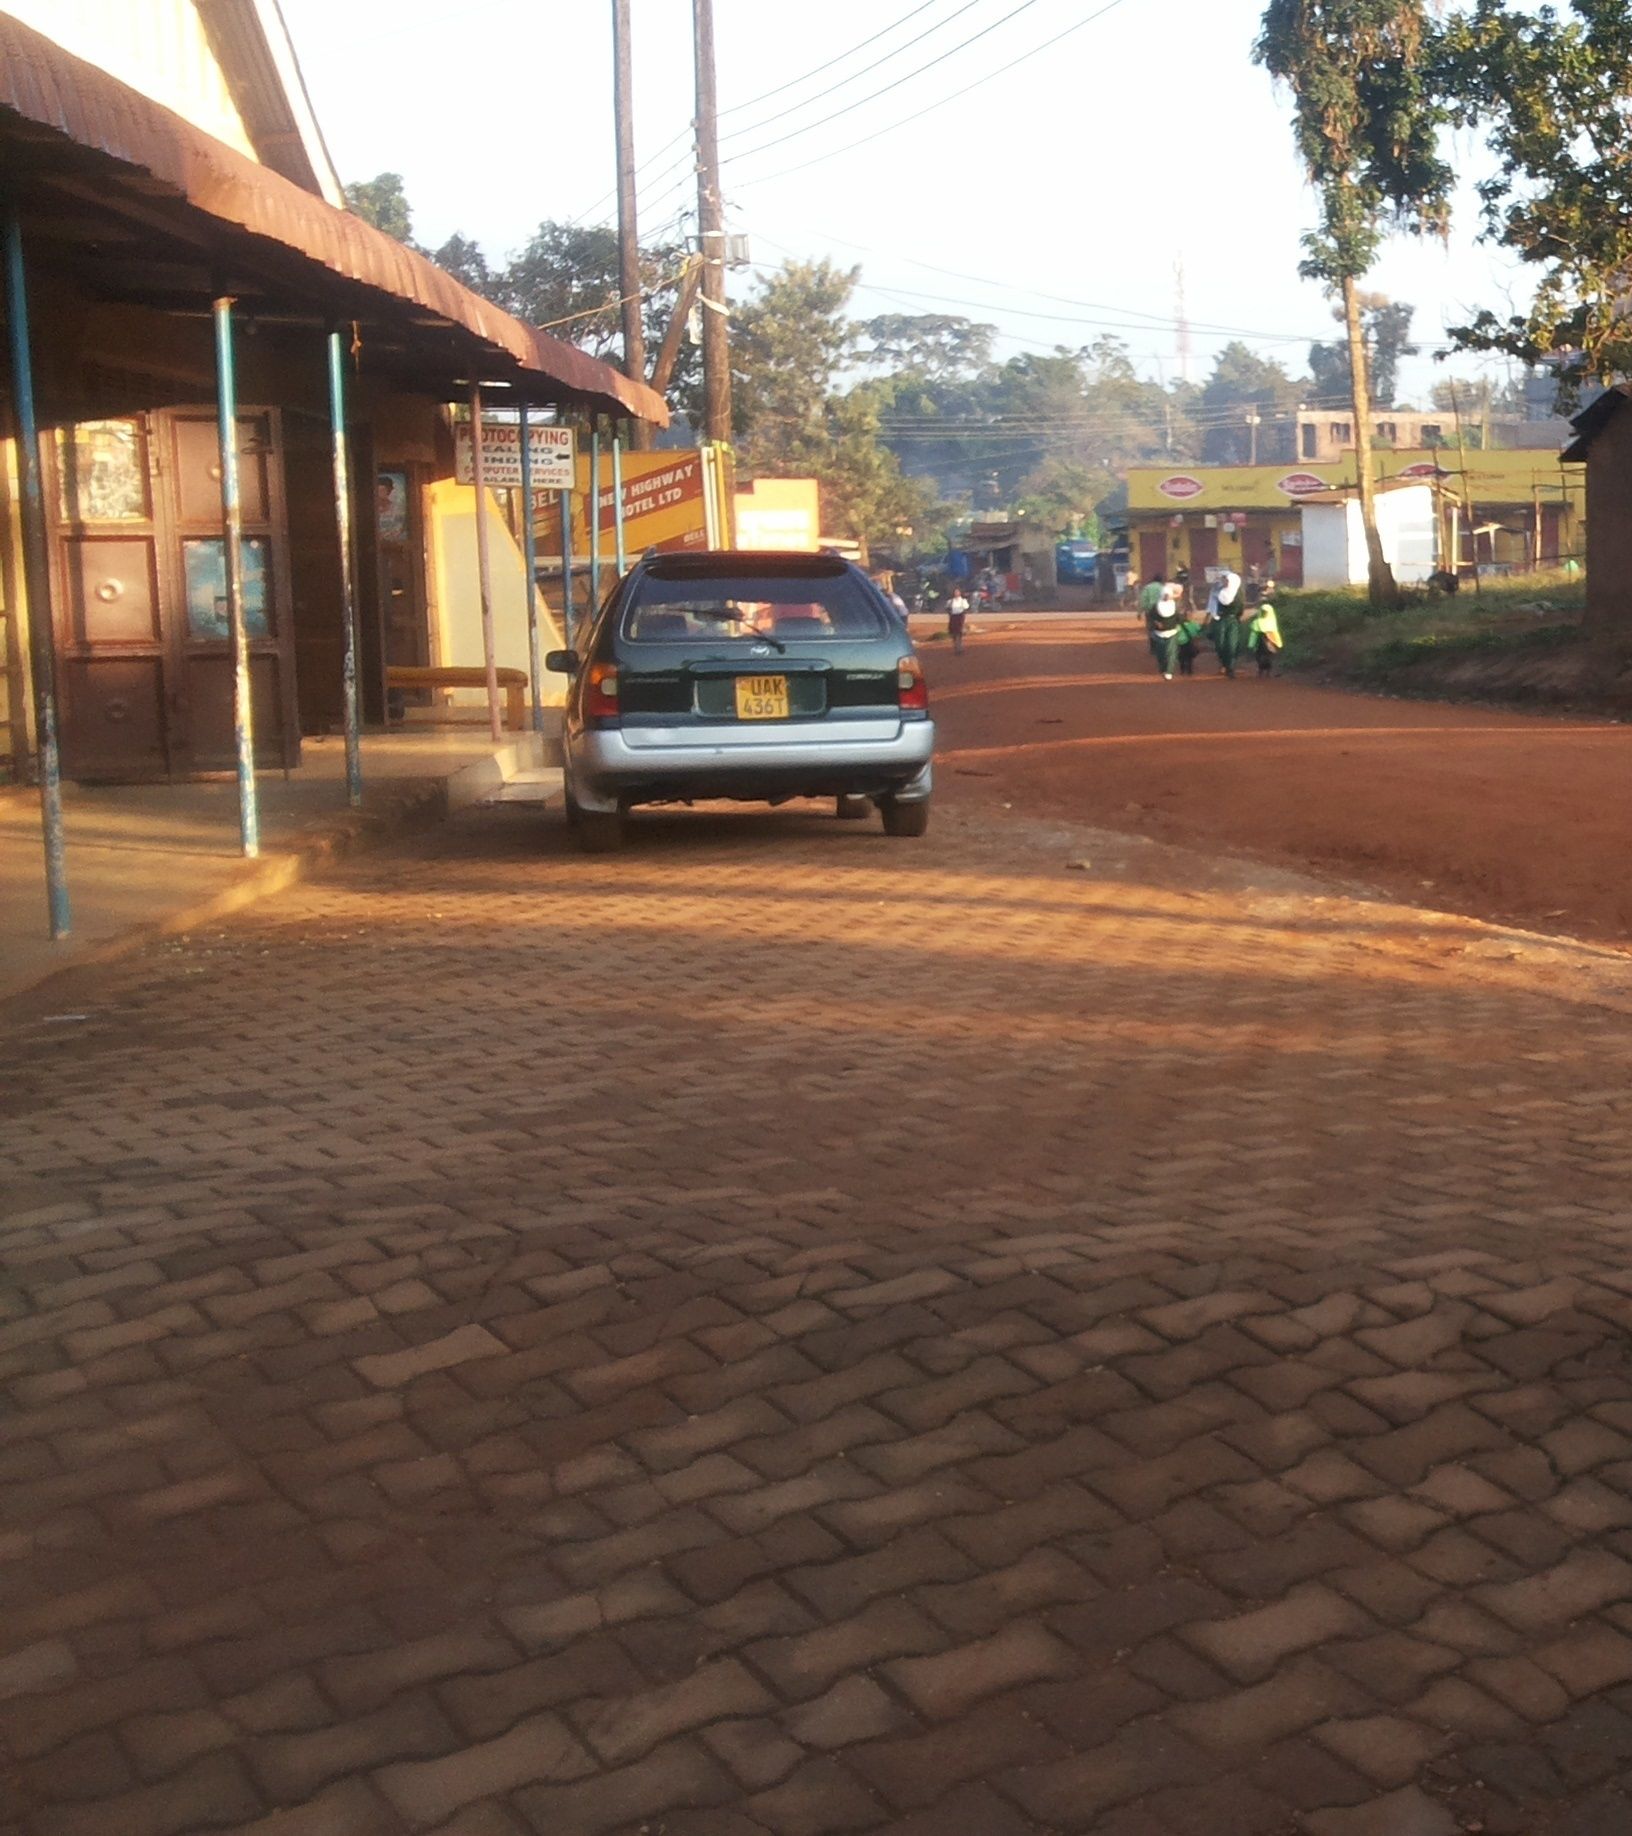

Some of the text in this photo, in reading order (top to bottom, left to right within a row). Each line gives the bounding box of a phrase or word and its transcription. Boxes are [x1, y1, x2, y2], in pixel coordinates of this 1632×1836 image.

[631, 464, 694, 497] HIGHWAY
[658, 487, 683, 506] LTD
[751, 678, 783, 697] UAK
[744, 698, 784, 715] 436T
